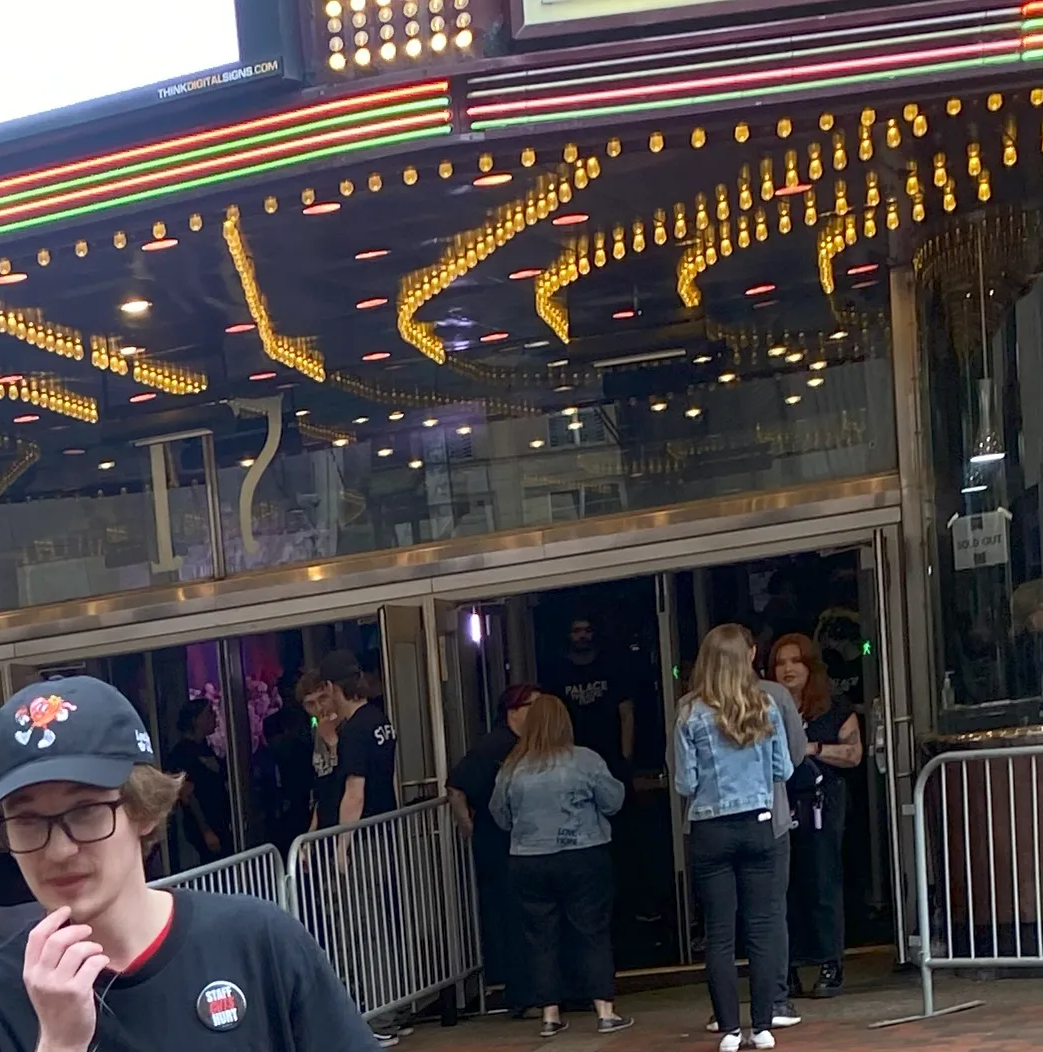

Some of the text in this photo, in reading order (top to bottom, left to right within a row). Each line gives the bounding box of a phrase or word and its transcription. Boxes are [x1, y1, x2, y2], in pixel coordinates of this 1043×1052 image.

[158, 60, 278, 99] THINKDIGITALSIGNS.COM
[565, 680, 608, 695] PALACE
[205, 986, 232, 1003] STAFF
[212, 1007, 238, 1027] HURT
